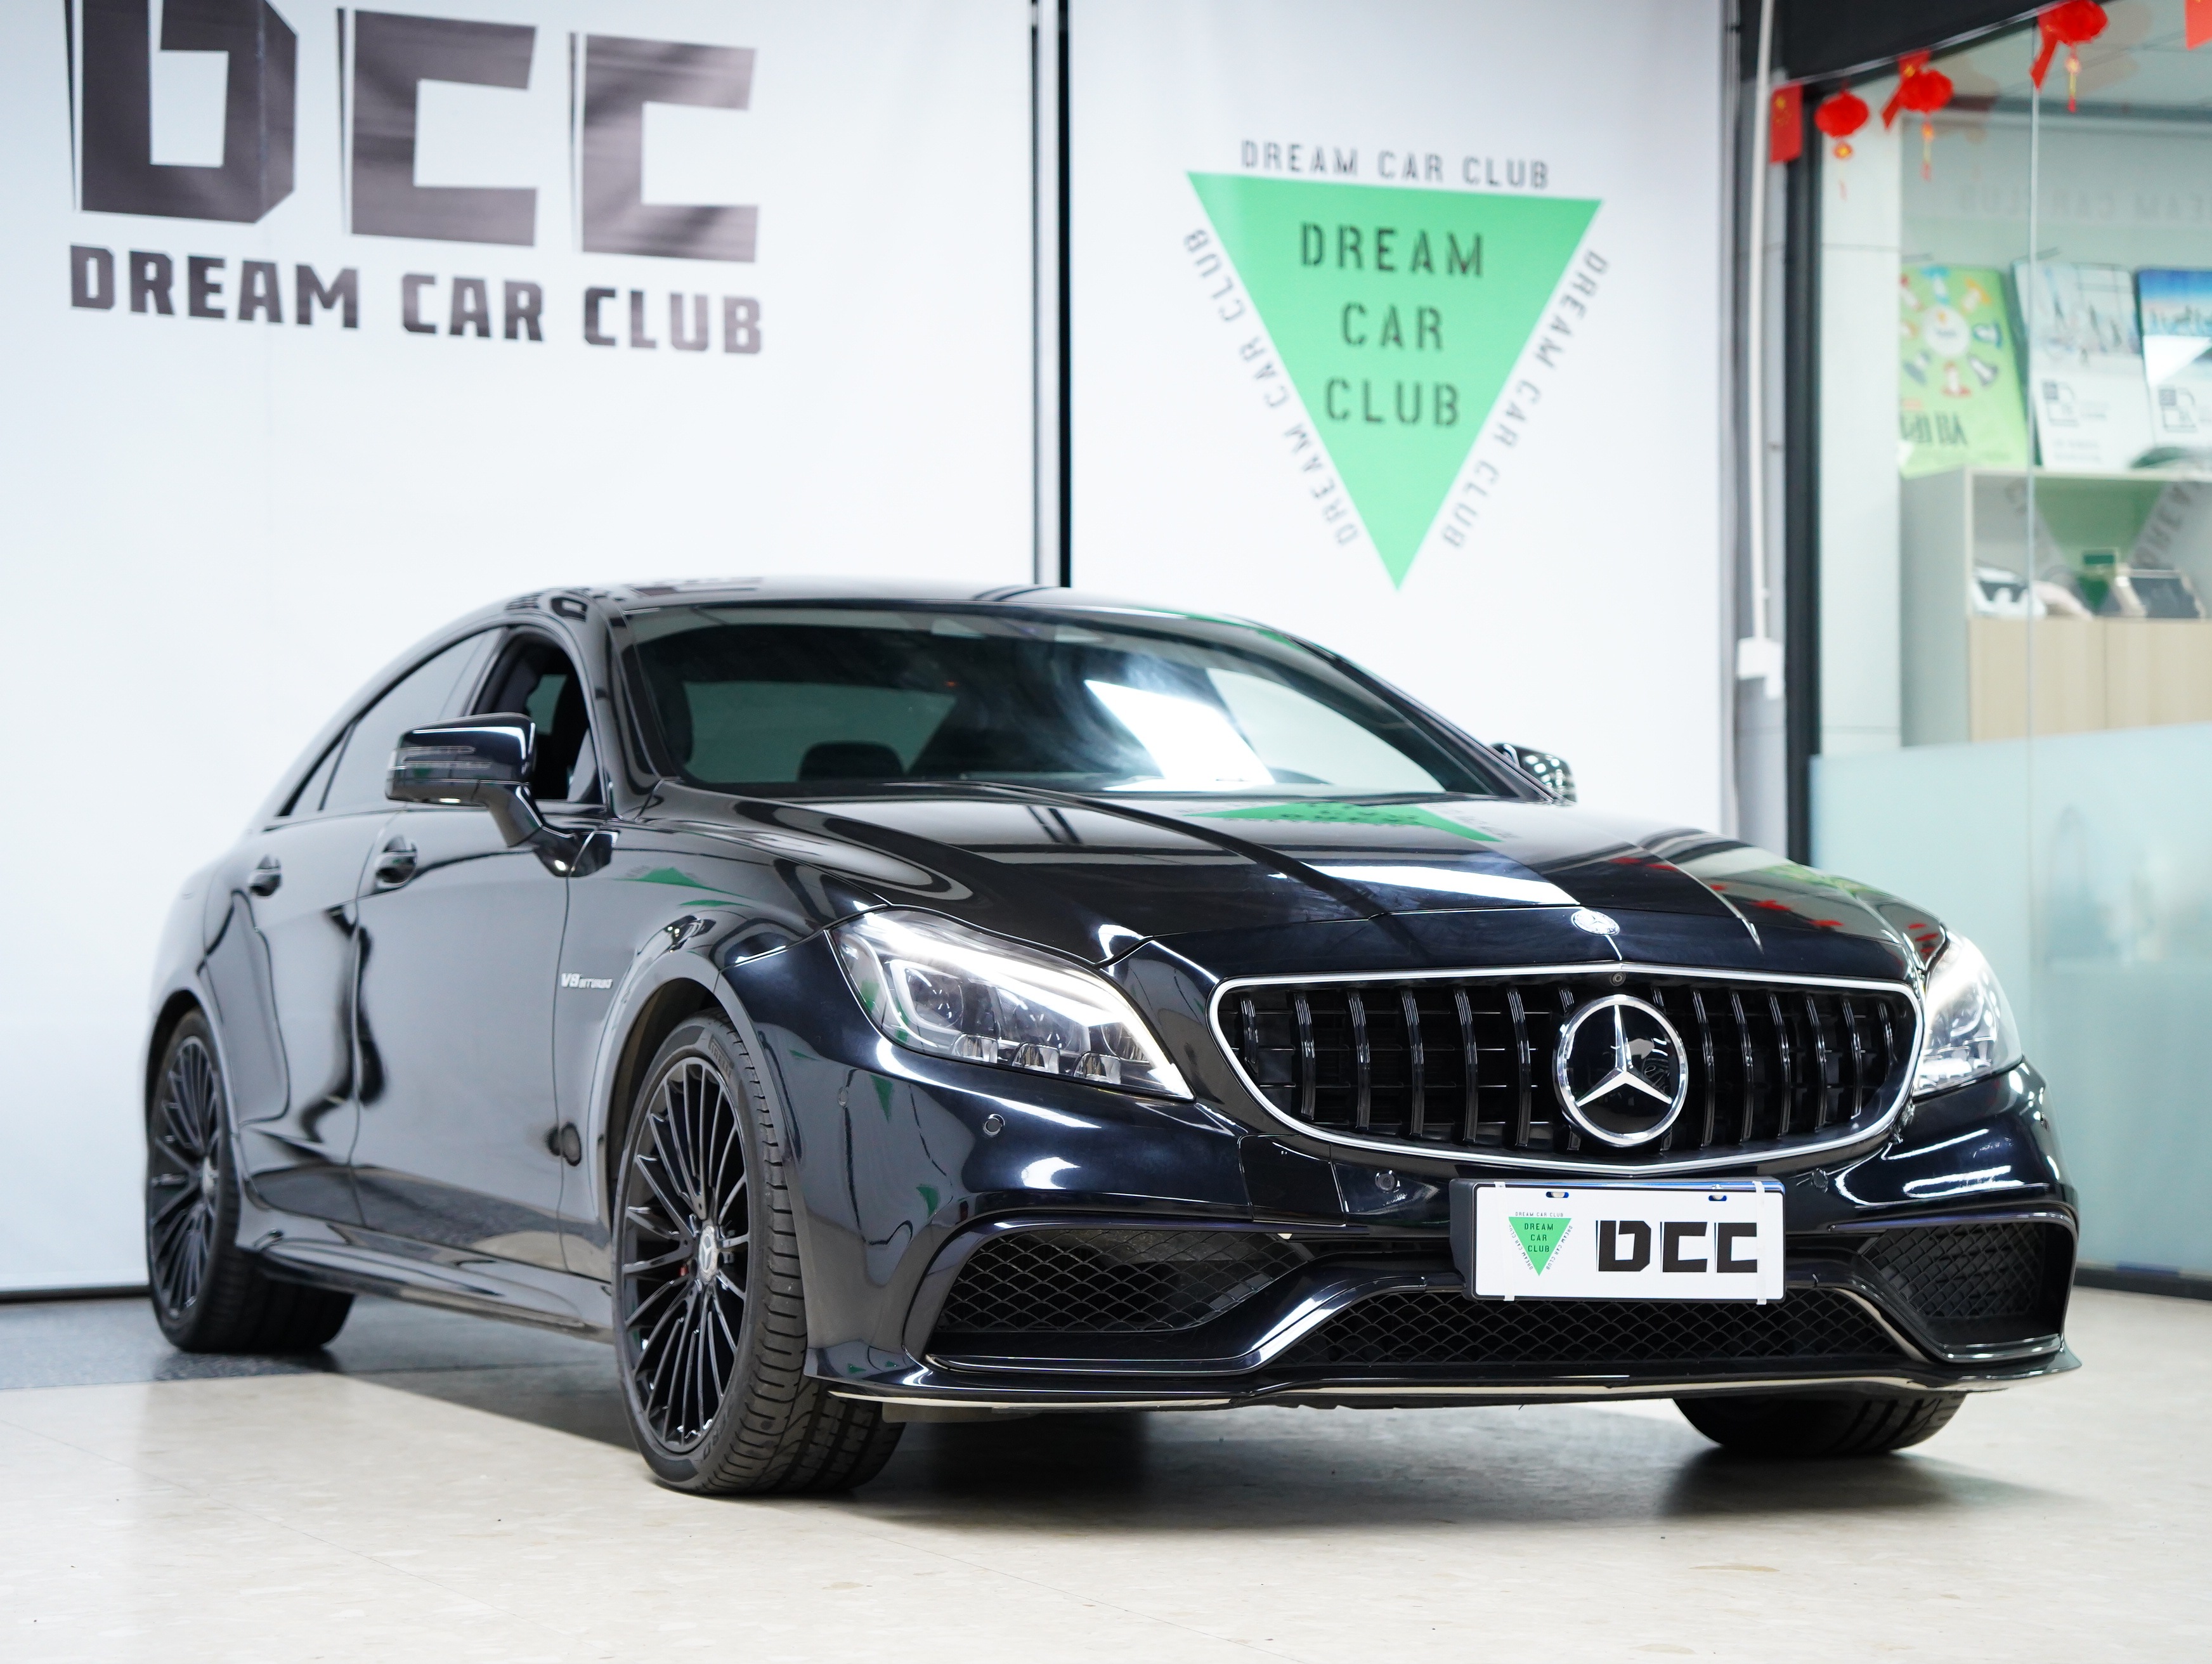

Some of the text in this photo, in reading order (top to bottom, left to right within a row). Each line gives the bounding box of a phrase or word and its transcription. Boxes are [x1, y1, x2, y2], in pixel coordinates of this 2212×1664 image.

[64, 0, 758, 263] DCC
[1241, 140, 1549, 190] DREAM CAR CLUB
[1301, 222, 1483, 277] DREAM
[69, 244, 762, 355] DREAM CAR CLUB
[1341, 302, 1443, 351] CAR
[1183, 228, 1359, 546] DREAM CAR CLUB
[1324, 377, 1460, 429] CLUB
[1441, 249, 1609, 547] DREAM CAR CLUB
[561, 973, 582, 987] V8
[1524, 1223, 1554, 1231] DREAM
[1545, 1225, 1573, 1270] DREAM CAR CLUB
[1596, 1219, 1758, 1273] DCC
